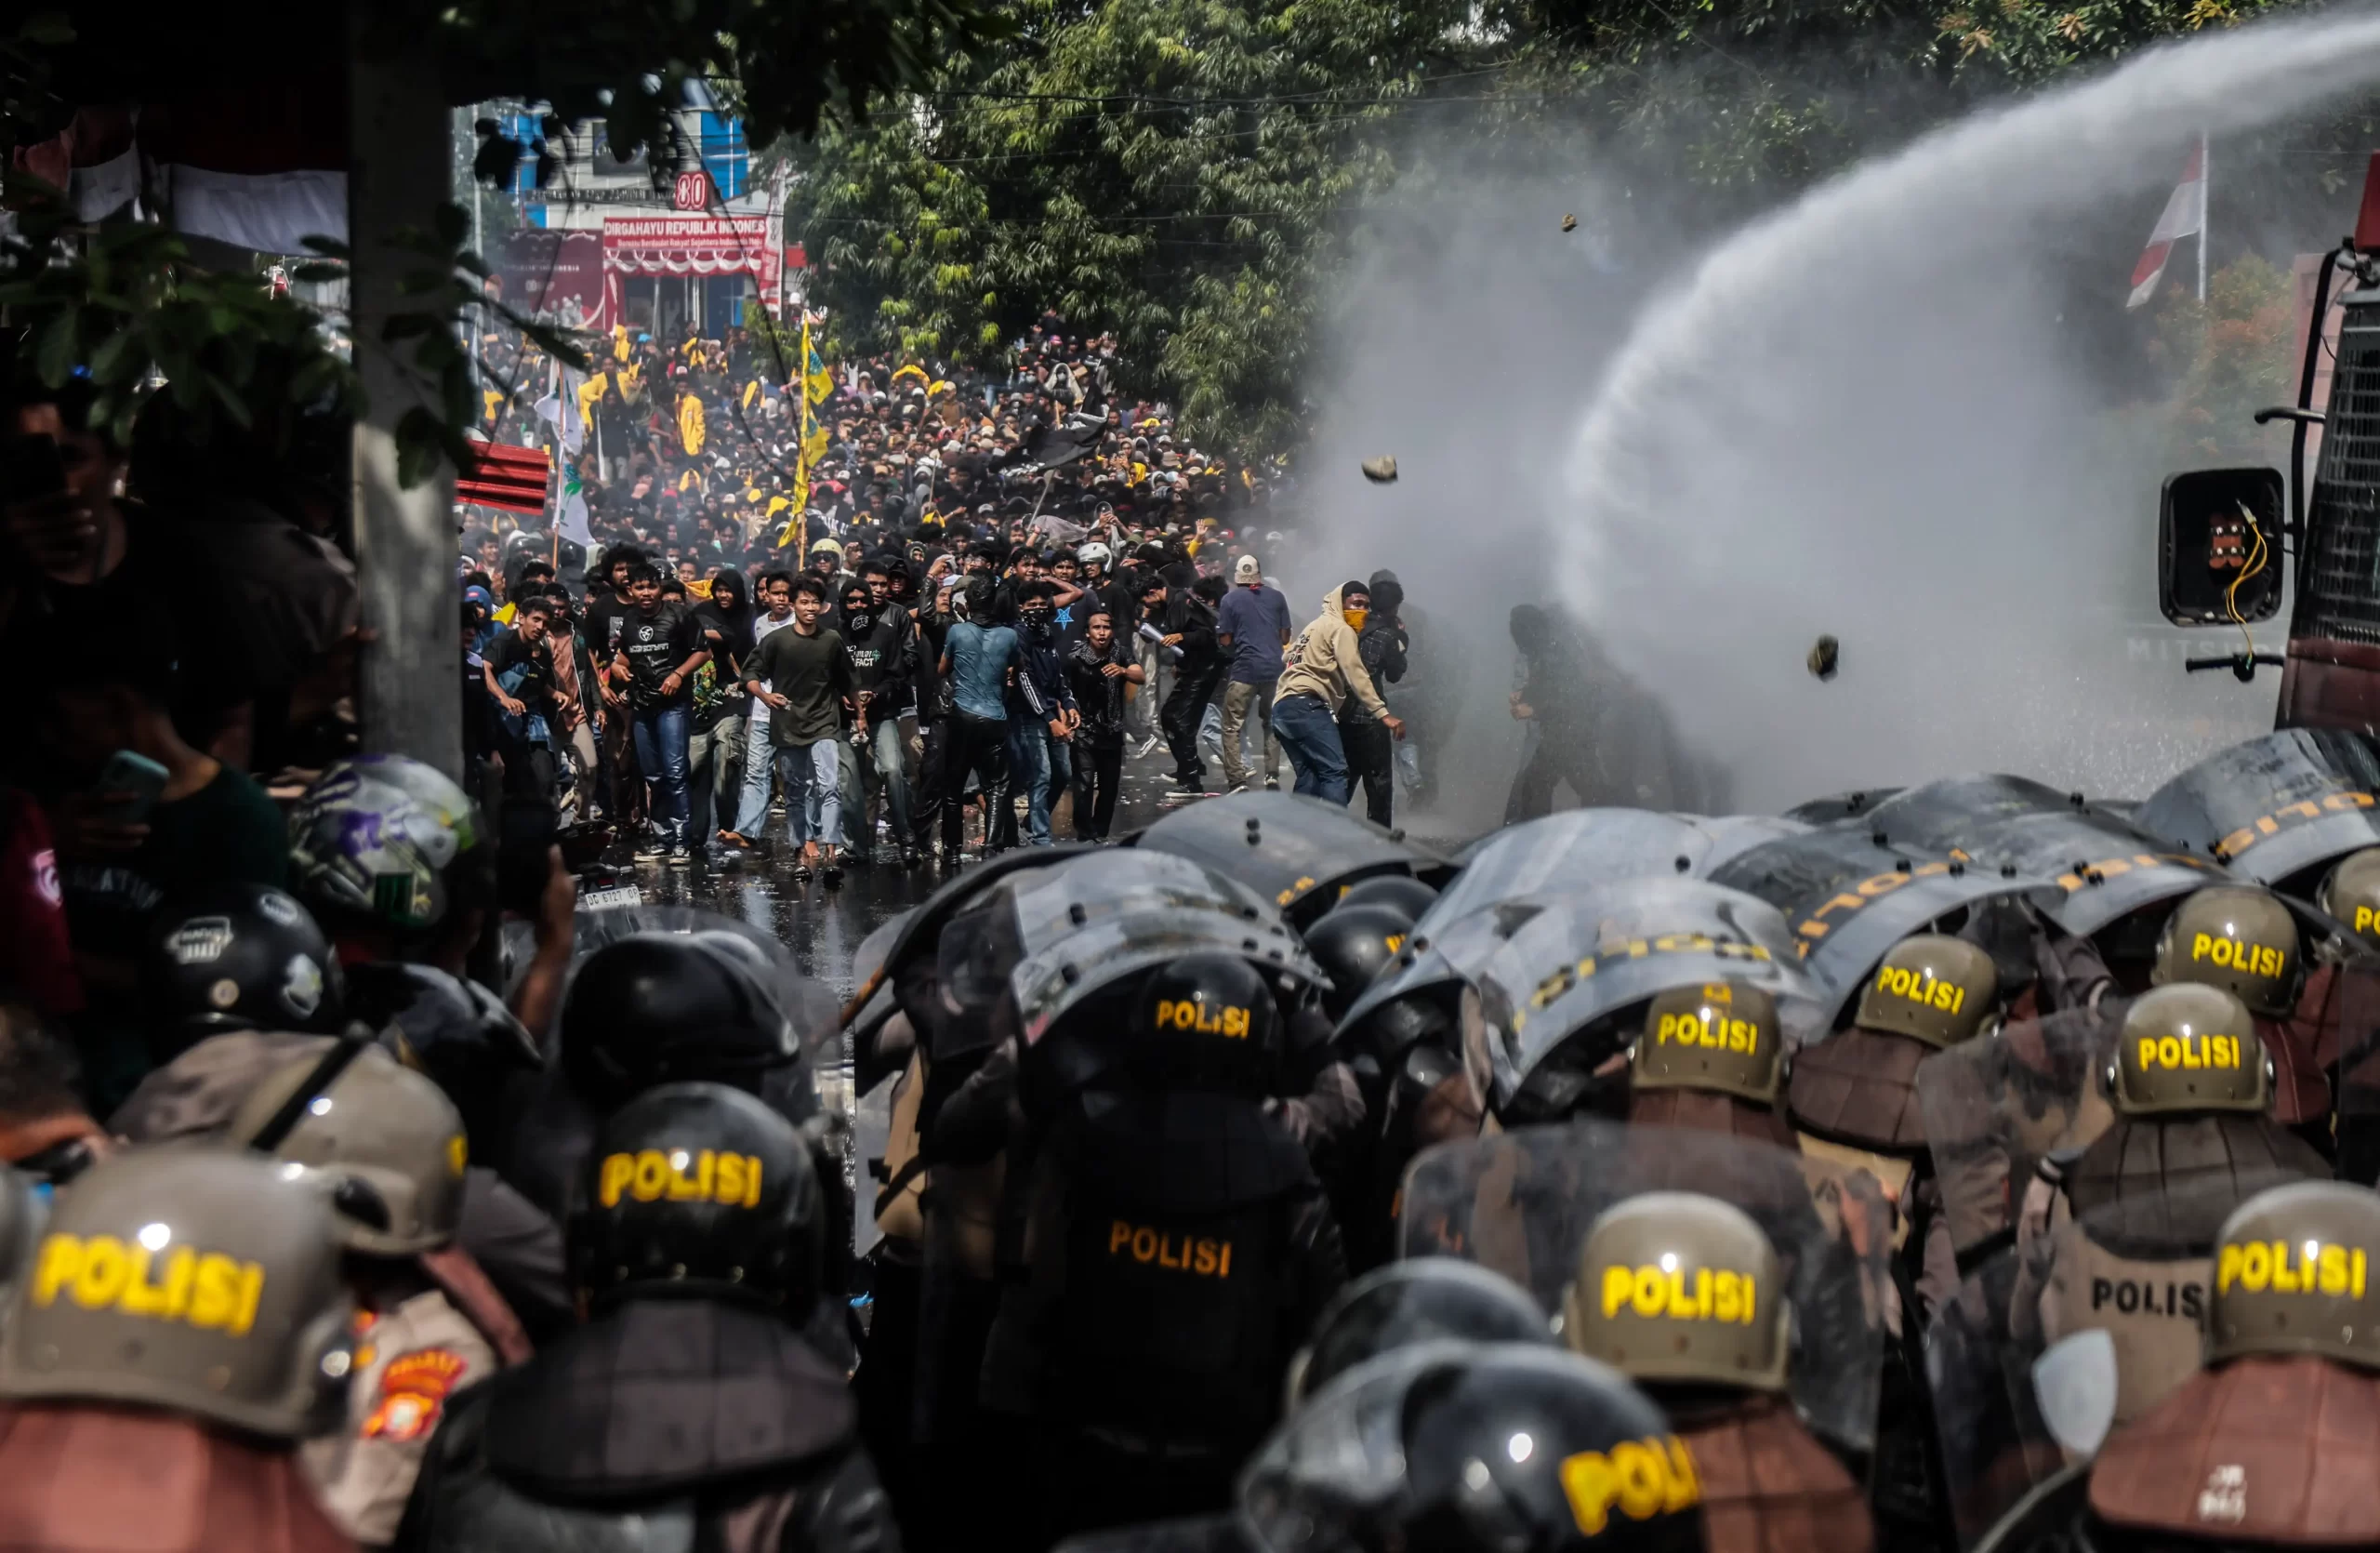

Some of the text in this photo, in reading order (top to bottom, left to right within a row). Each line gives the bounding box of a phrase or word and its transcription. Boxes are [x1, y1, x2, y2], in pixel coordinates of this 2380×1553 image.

[678, 174, 706, 208] 80
[604, 221, 665, 236] DIRGAHAYU
[666, 220, 717, 235] REPUBLIK
[602, 890, 622, 902] 6727
[2190, 931, 2285, 979] POLISI
[1876, 964, 1965, 1015] POLISI
[1155, 999, 1251, 1041] POLISI
[1656, 1011, 1758, 1056] POLISI
[2136, 1033, 2241, 1072] POLISI
[599, 1148, 762, 1211] POLISI
[1109, 1219, 1232, 1279] POLISI
[2217, 1241, 2368, 1300] POLISI
[33, 1234, 265, 1335] POLISI
[1600, 1264, 1756, 1326] POLISI
[2091, 1276, 2204, 1320] POLIS
